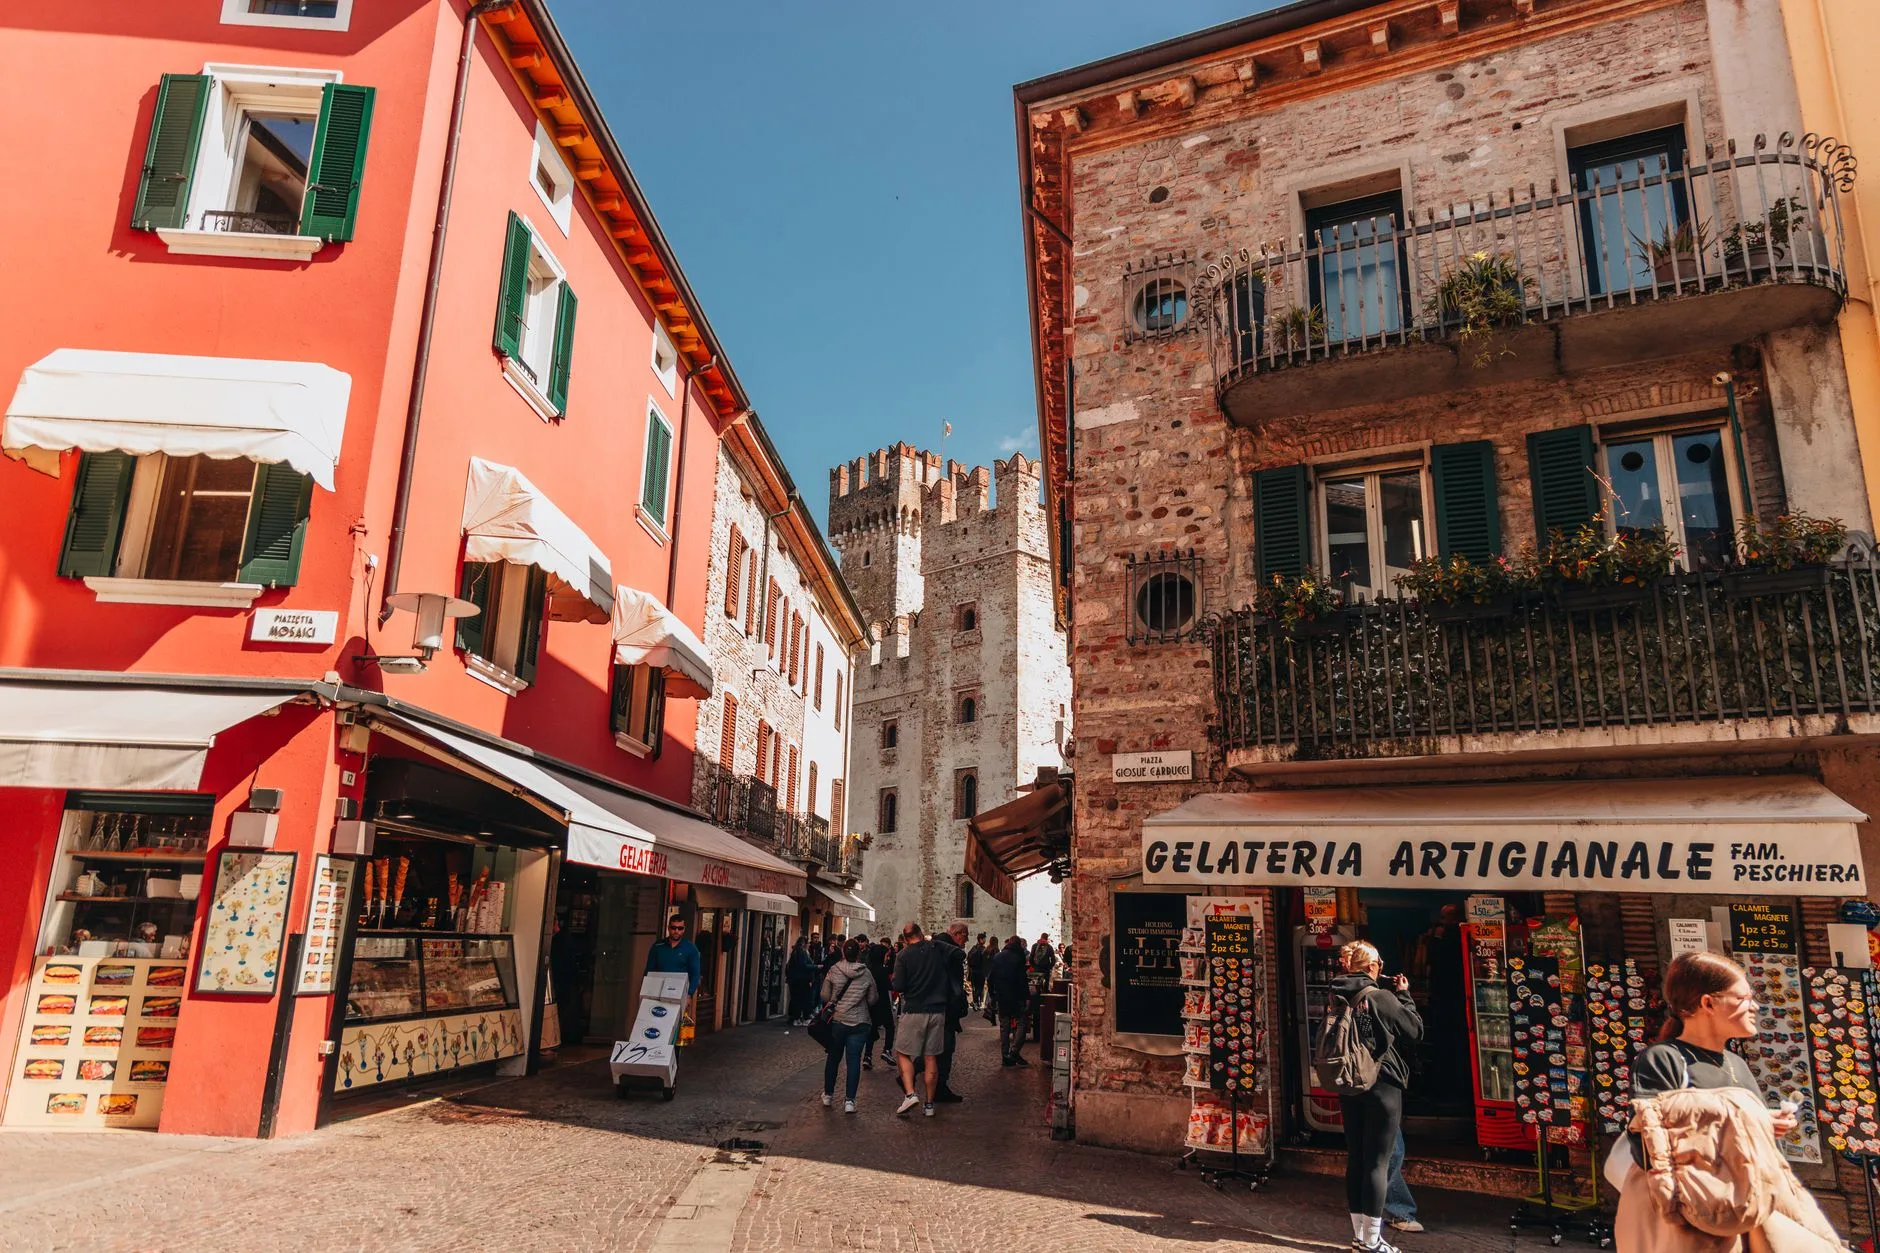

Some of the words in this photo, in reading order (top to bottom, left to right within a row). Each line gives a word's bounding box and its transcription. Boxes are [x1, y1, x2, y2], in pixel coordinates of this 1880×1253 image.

[274, 614, 313, 624] PIAZZETTA
[268, 625, 316, 638] MOSAICI
[1140, 756, 1163, 764] PIAZZA
[1115, 767, 1147, 777] GIOSUE
[1149, 765, 1190, 777] CARDUCCI
[1730, 842, 1785, 861] FAM.
[619, 843, 667, 876] GELATERIA
[1145, 840, 1362, 878] GELATERIA
[1388, 840, 1715, 880] ARTIGIANALE
[1733, 863, 1860, 883] PESCHIERA
[1732, 904, 1770, 913] CALAMITE
[1754, 913, 1789, 922] MAGNETE
[1127, 927, 1150, 935] STUDIO
[1150, 928, 1183, 936] IMMOBILIA
